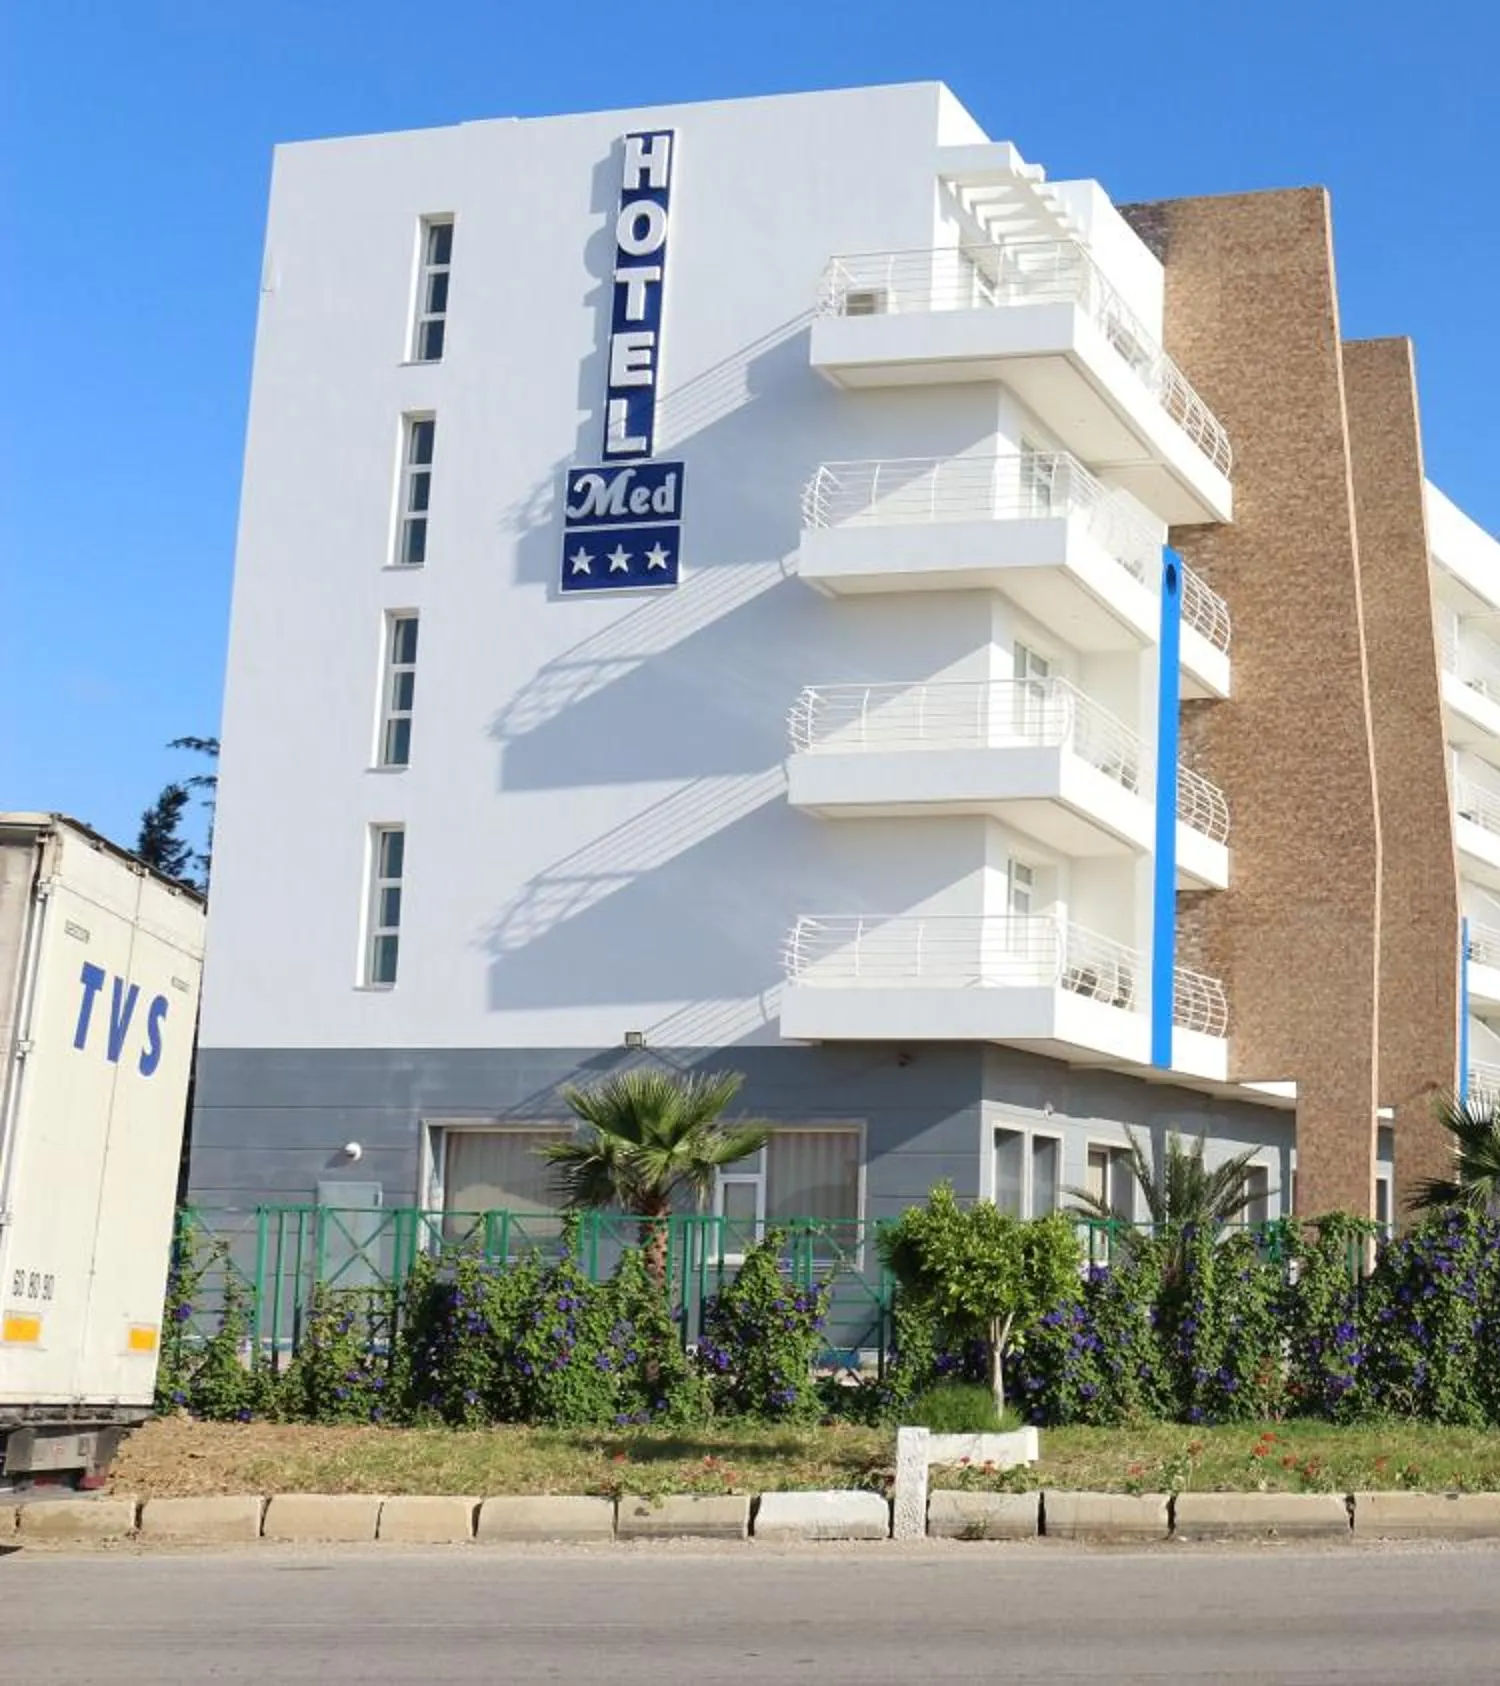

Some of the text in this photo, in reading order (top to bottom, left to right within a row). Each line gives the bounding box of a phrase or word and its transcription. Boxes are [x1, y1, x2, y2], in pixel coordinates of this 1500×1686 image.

[606, 134, 669, 454] HOTEL
[566, 469, 677, 519] Med
[73, 960, 169, 1077] TVS
